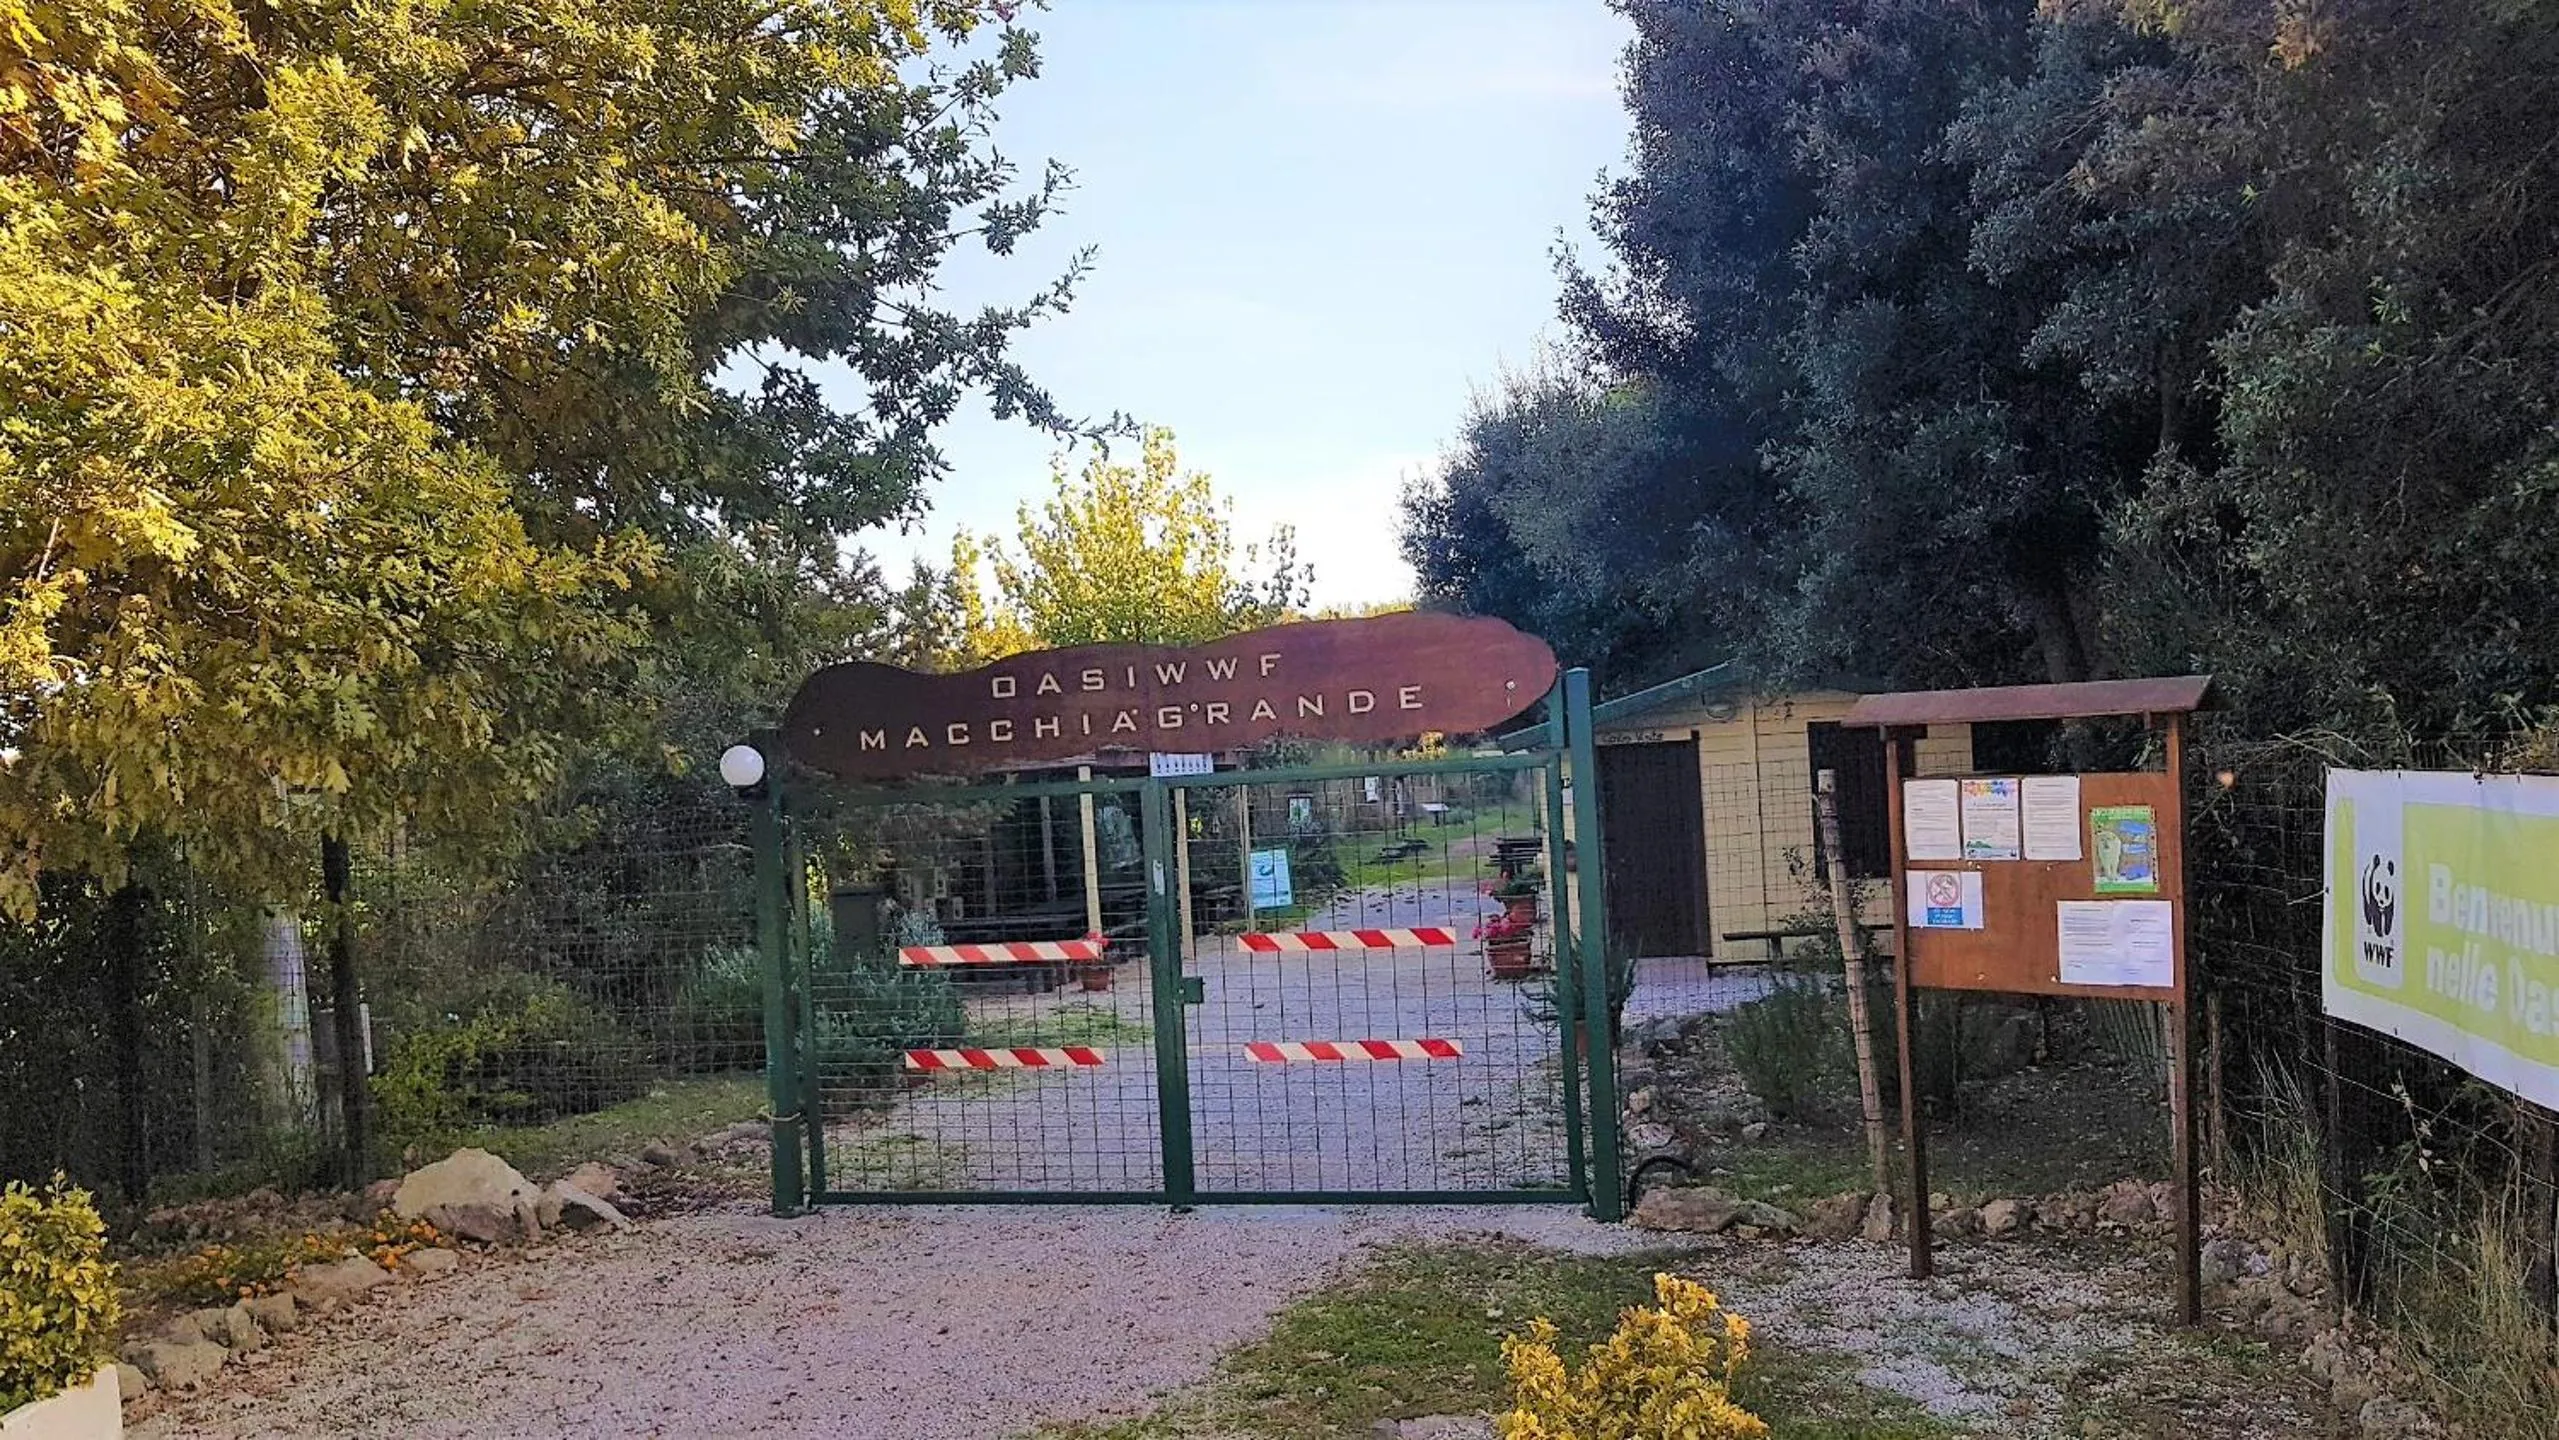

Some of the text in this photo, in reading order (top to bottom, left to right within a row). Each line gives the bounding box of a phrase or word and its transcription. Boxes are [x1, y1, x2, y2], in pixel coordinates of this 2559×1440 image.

[2427, 862, 2559, 957] Benvenu
[2364, 941, 2395, 969] WWF
[2426, 939, 2499, 1012] nelle
